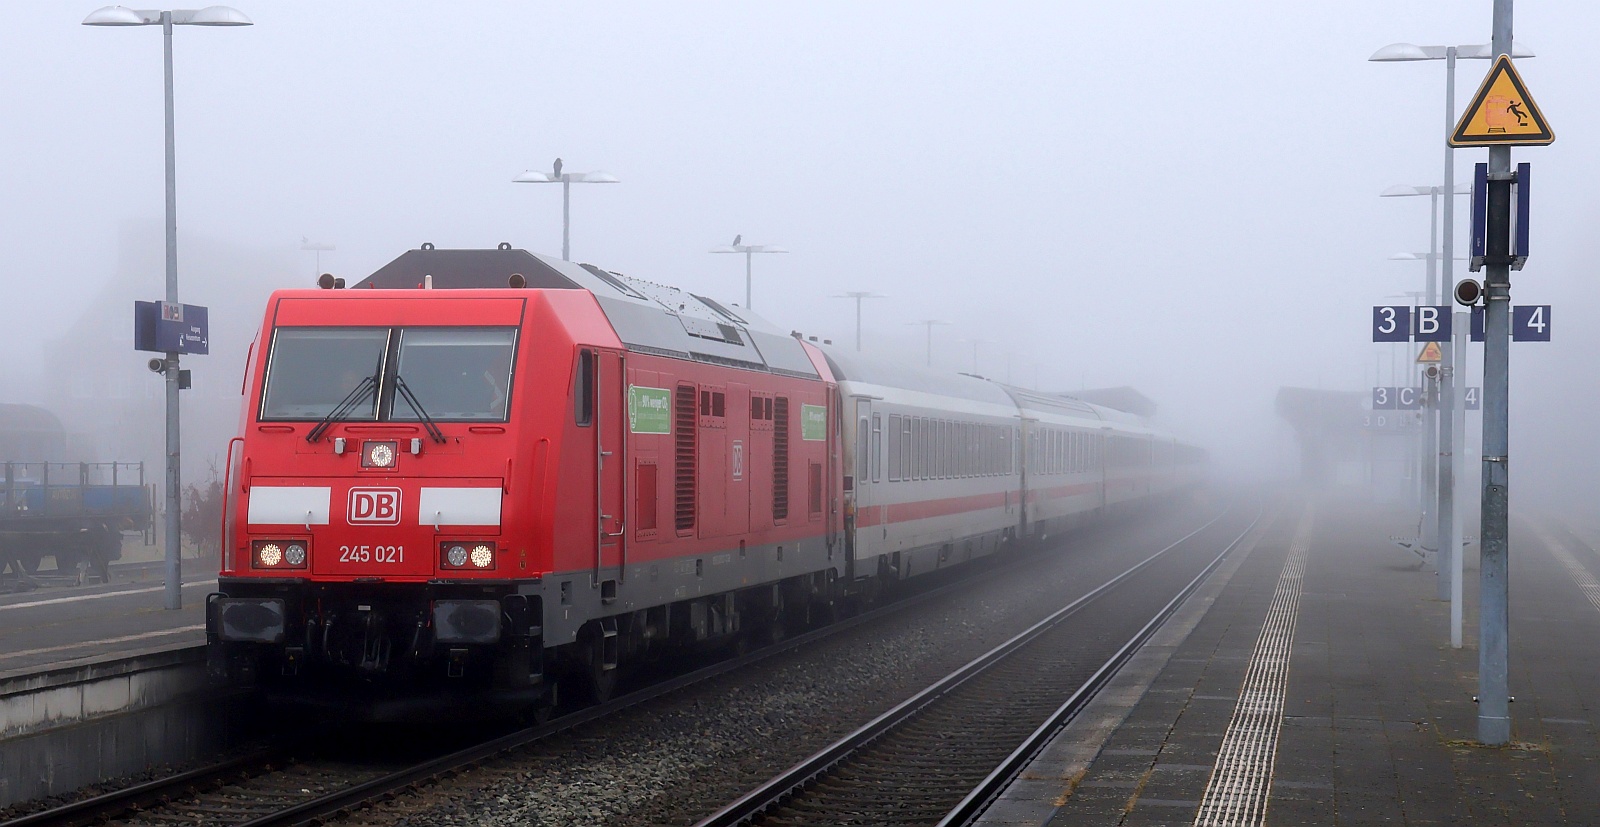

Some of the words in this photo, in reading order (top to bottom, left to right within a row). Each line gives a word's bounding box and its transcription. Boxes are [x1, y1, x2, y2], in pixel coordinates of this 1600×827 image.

[1378, 307, 1396, 334] 3
[1419, 307, 1439, 334] B
[1527, 306, 1546, 333] 4
[1376, 388, 1387, 405] 3
[1400, 388, 1414, 405] C
[1465, 388, 1476, 405] 4
[1363, 416, 1370, 426] 3
[1377, 416, 1386, 426] D
[354, 493, 394, 519] DB
[339, 545, 370, 563] 245
[375, 545, 404, 563] 021
